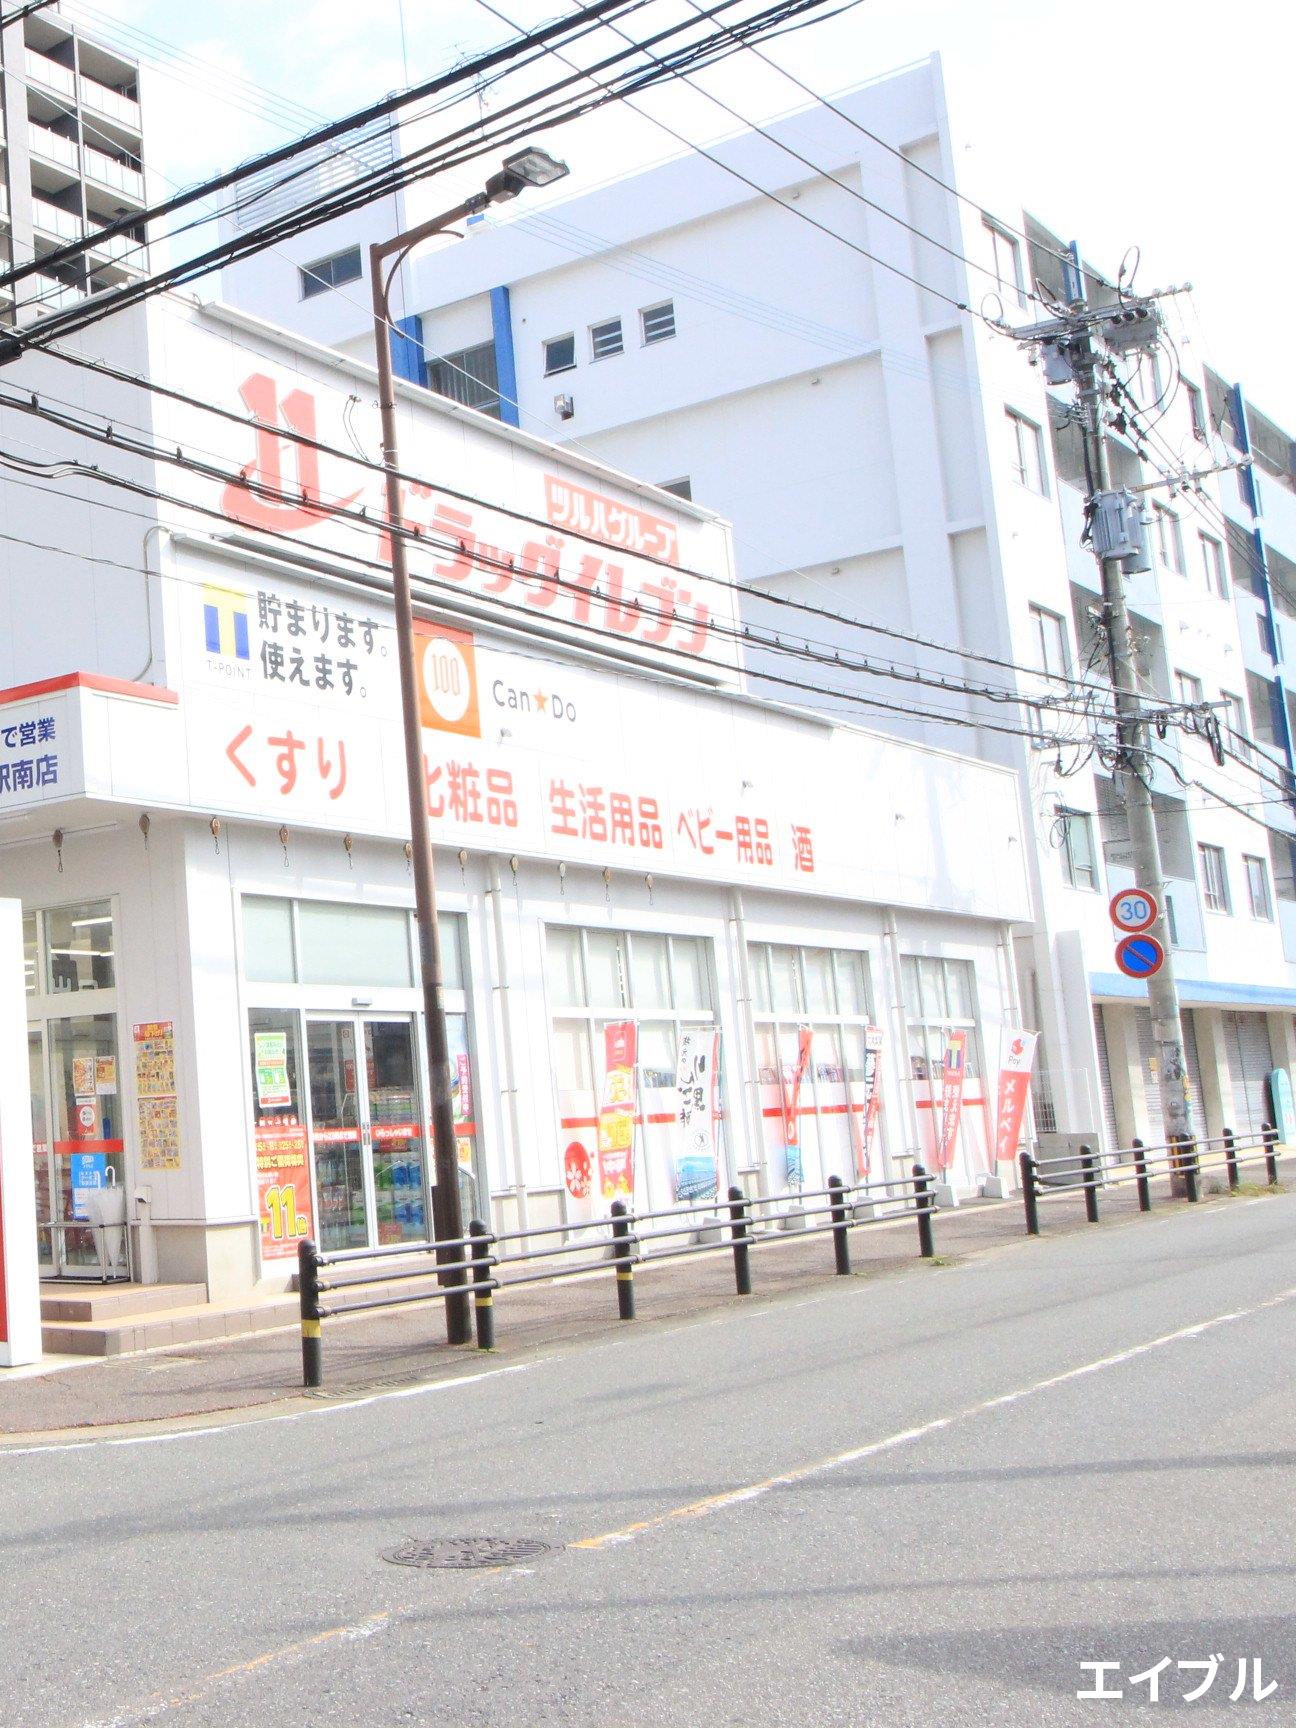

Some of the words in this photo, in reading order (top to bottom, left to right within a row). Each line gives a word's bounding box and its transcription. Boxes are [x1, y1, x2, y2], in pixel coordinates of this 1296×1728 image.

[257, 590, 388, 657] 貯まります。
[260, 640, 367, 698] 使えます。
[226, 725, 346, 800] くすり
[549, 780, 663, 849] 生活用品
[677, 806, 773, 866] ベビー用品
[791, 823, 814, 873] 酒
[1120, 900, 1147, 920] 30
